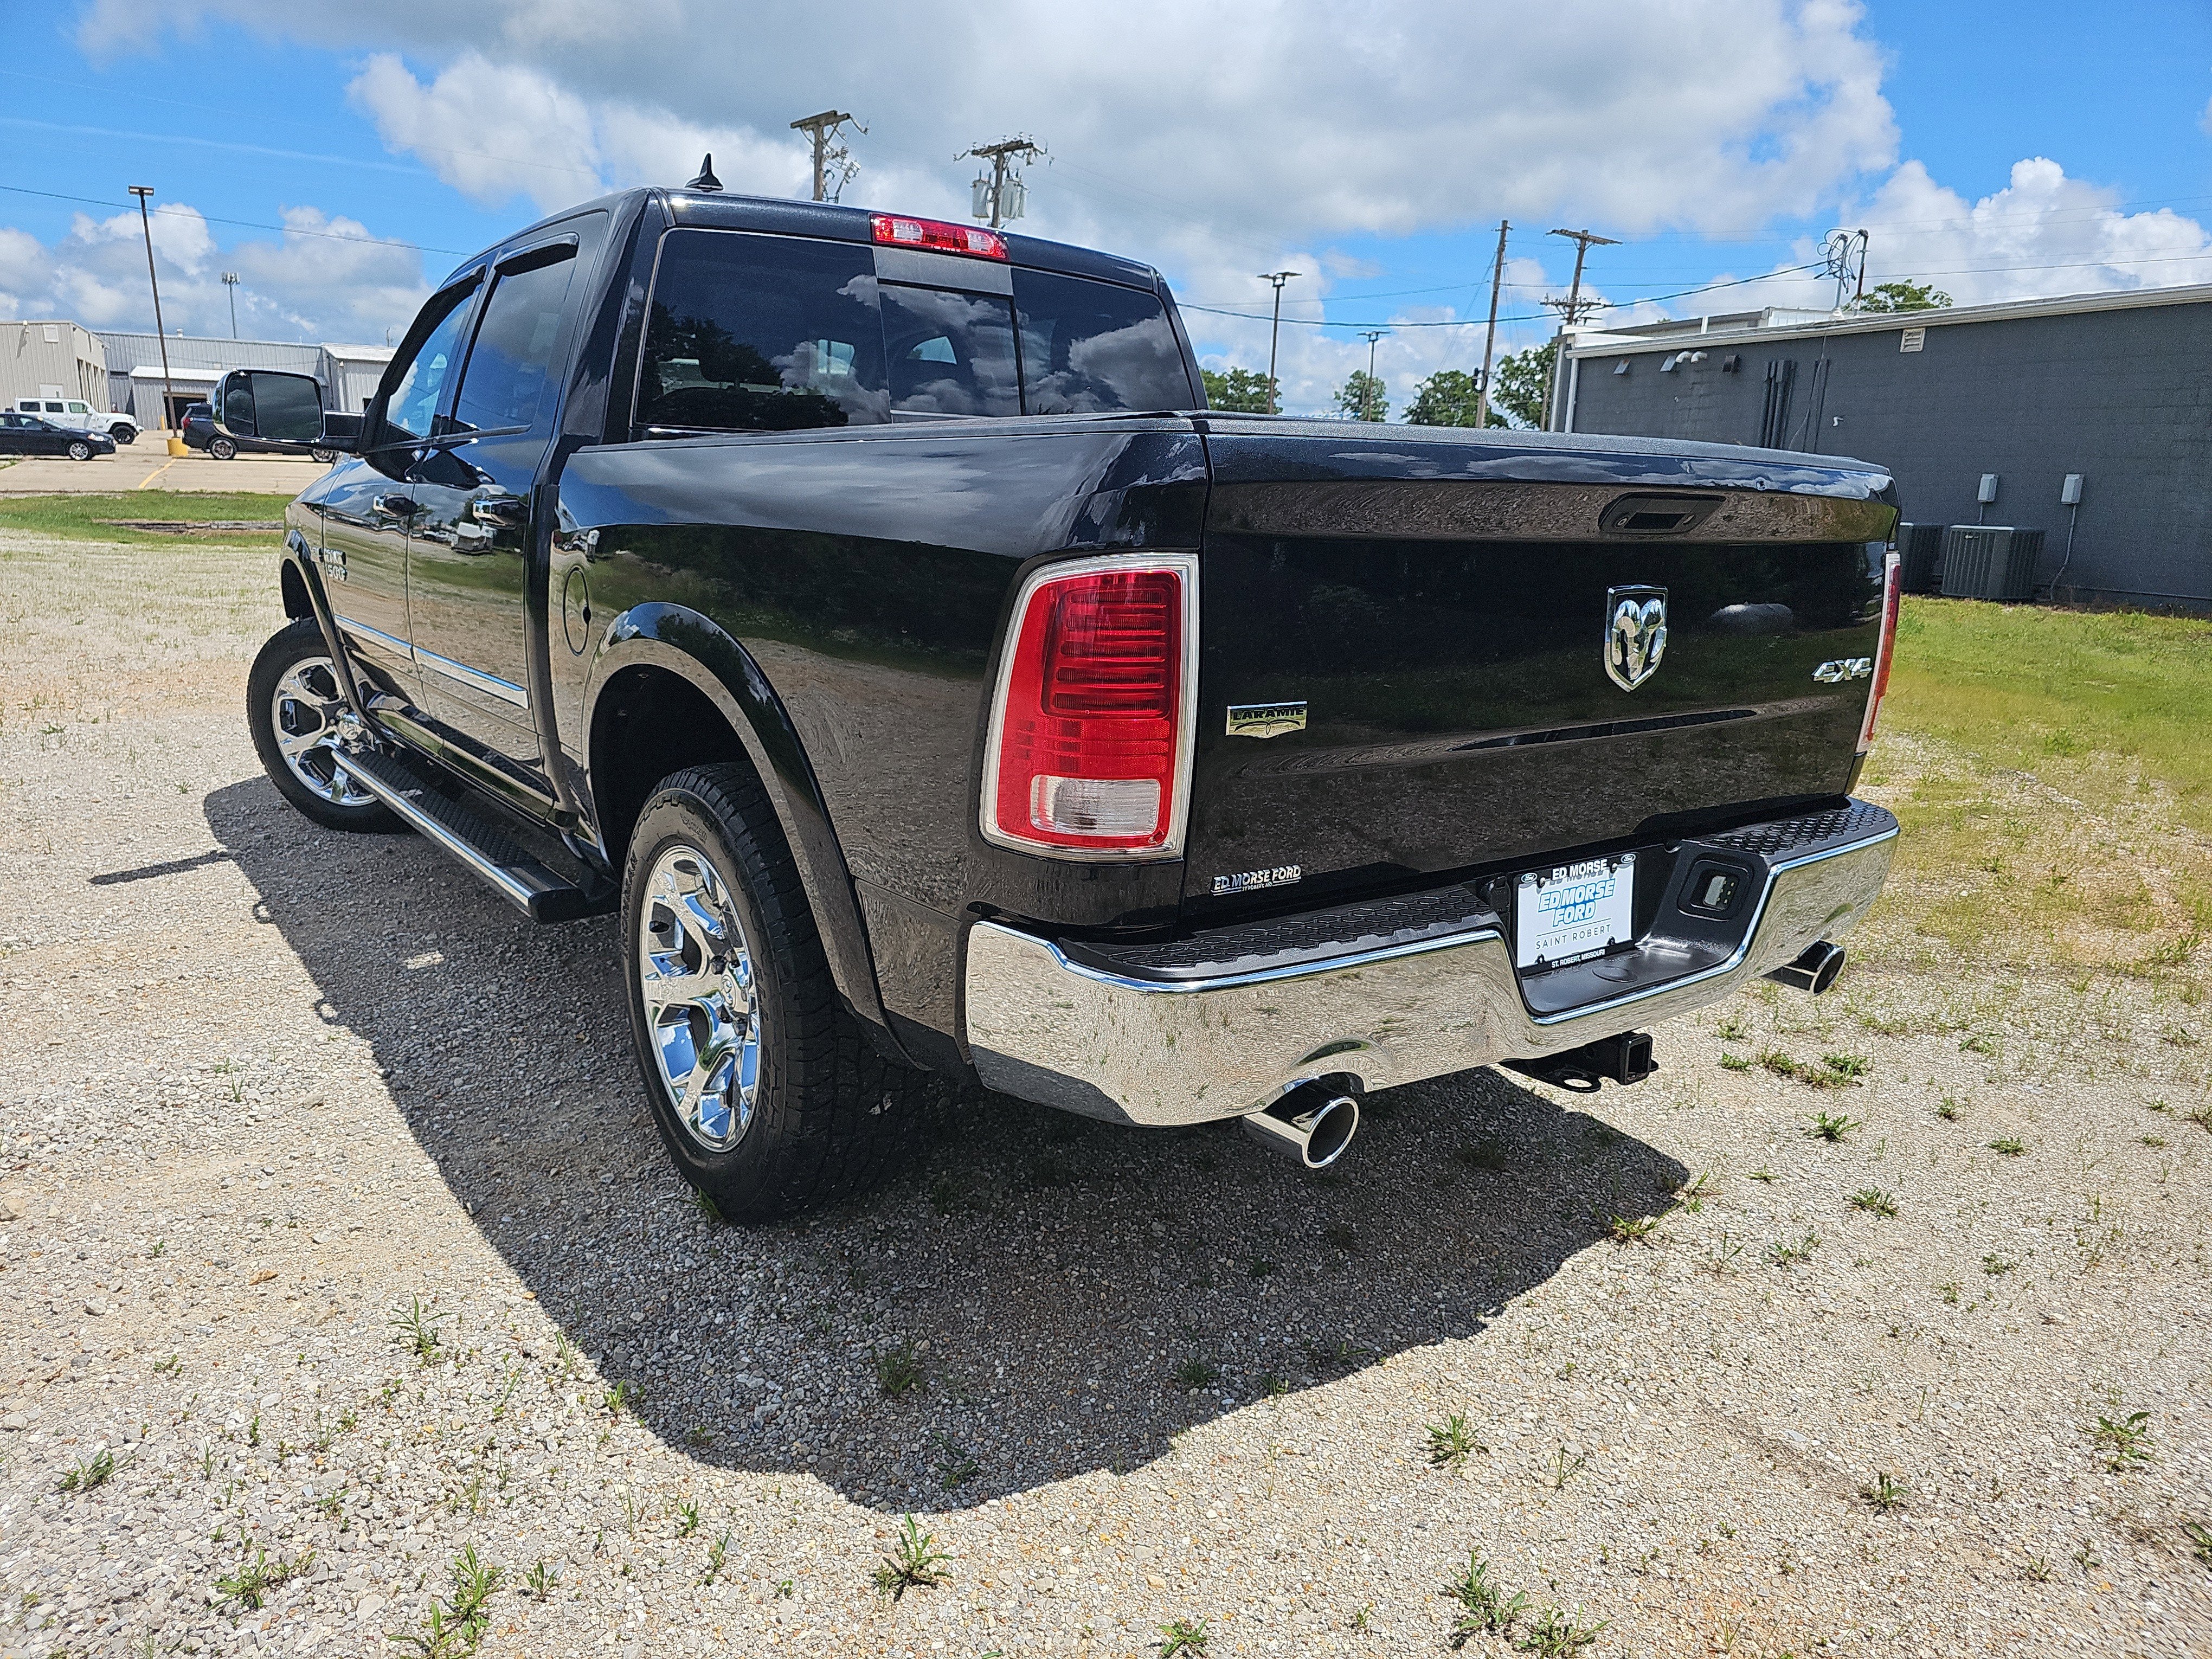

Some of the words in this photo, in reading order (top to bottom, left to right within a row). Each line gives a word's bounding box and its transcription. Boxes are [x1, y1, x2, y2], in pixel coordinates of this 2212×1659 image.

[1233, 706, 1304, 721] LARAMIE
[1214, 876, 1230, 890] ED
[1231, 869, 1270, 888] MORSE
[1271, 865, 1301, 881] FORD
[1552, 867, 1567, 880] ED
[1569, 859, 1607, 877] MORSE
[1538, 891, 1561, 912] ED
[1561, 878, 1616, 908] MORSE
[1553, 900, 1596, 927] FORD
[1535, 935, 1567, 949] SAINT
[1572, 924, 1611, 941] ROBERT
[1581, 948, 1605, 961] MISSOURI
